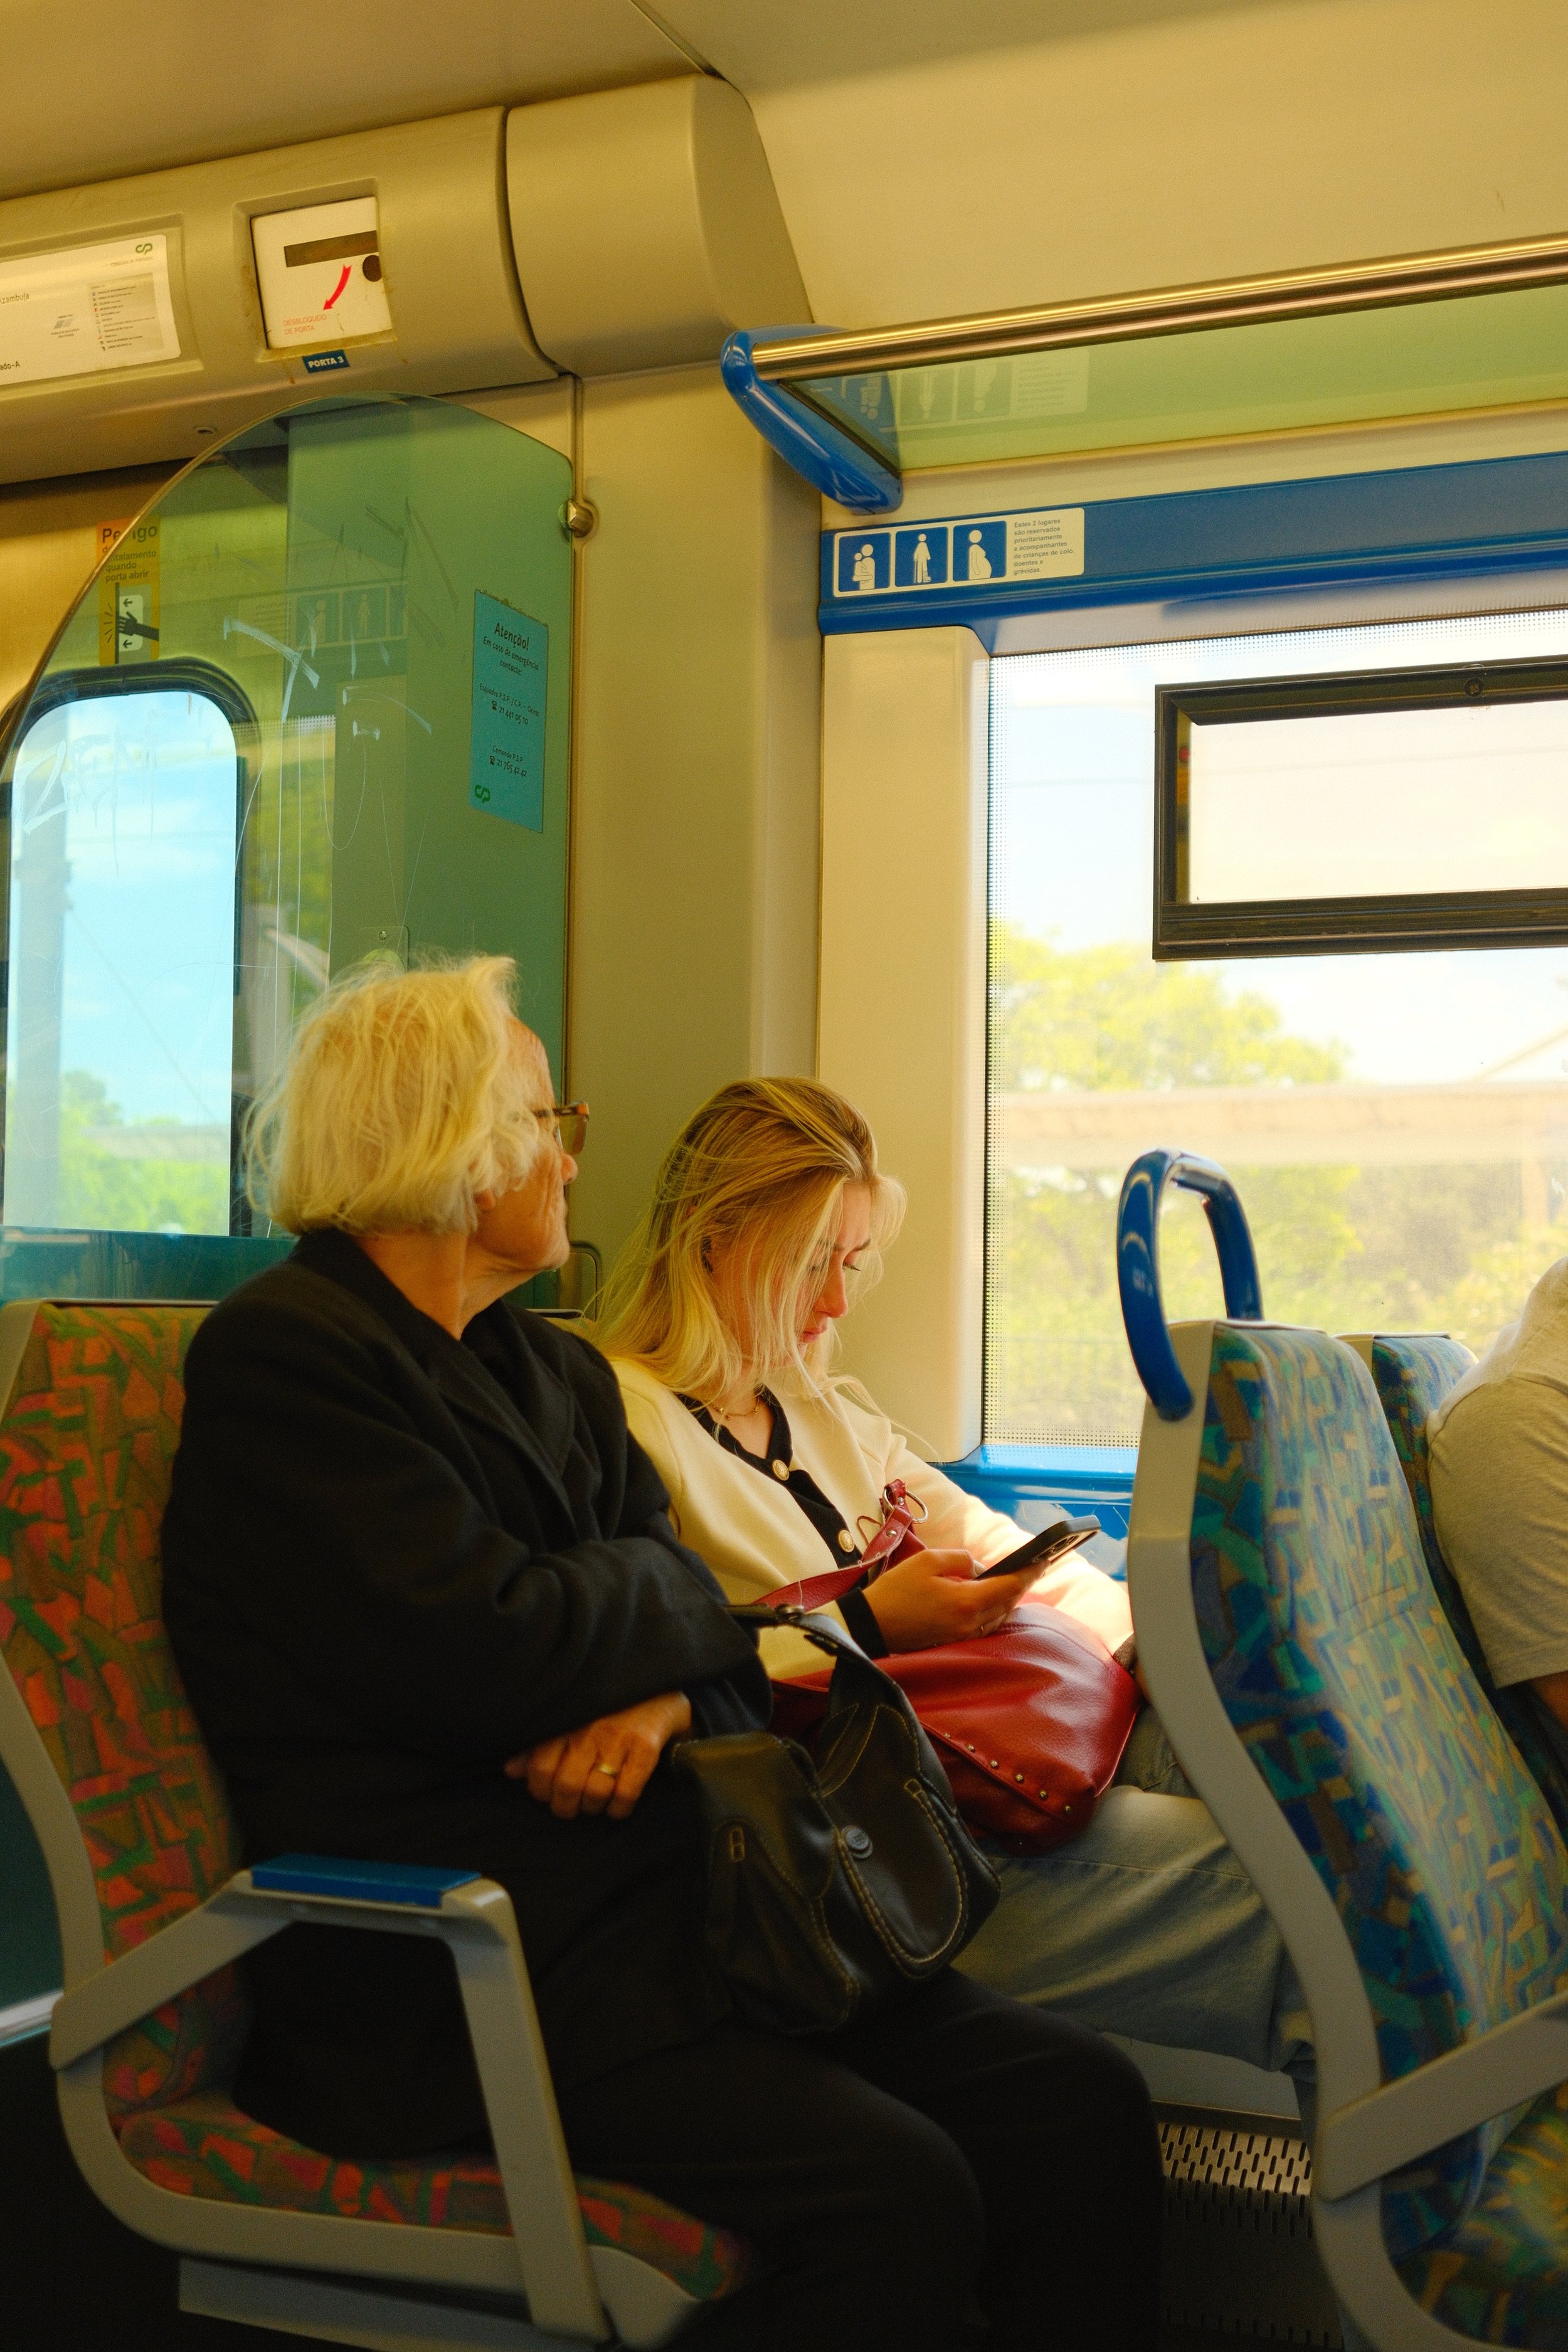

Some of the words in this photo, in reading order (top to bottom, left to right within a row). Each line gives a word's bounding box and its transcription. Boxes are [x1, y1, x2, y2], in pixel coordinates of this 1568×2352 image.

[283, 314, 327, 326] DESBLOQUEIO
[308, 357, 337, 368] PORTA
[102, 526, 157, 544] Peigo
[1014, 534, 1062, 544] prioritariamente
[1019, 541, 1067, 550] acompanhantes
[105, 561, 136, 573] quando
[106, 573, 127, 583] porta
[129, 569, 149, 579] abrir
[494, 622, 529, 651] Atenção!
[483, 636, 492, 647] Em
[492, 643, 504, 653] caso
[504, 647, 511, 657] de
[512, 652, 539, 670] emergência
[506, 710, 514, 720] 441
[497, 758, 502, 767] 21
[504, 760, 513, 773] 765
[514, 766, 520, 775] 42
[521, 770, 527, 778] 42
